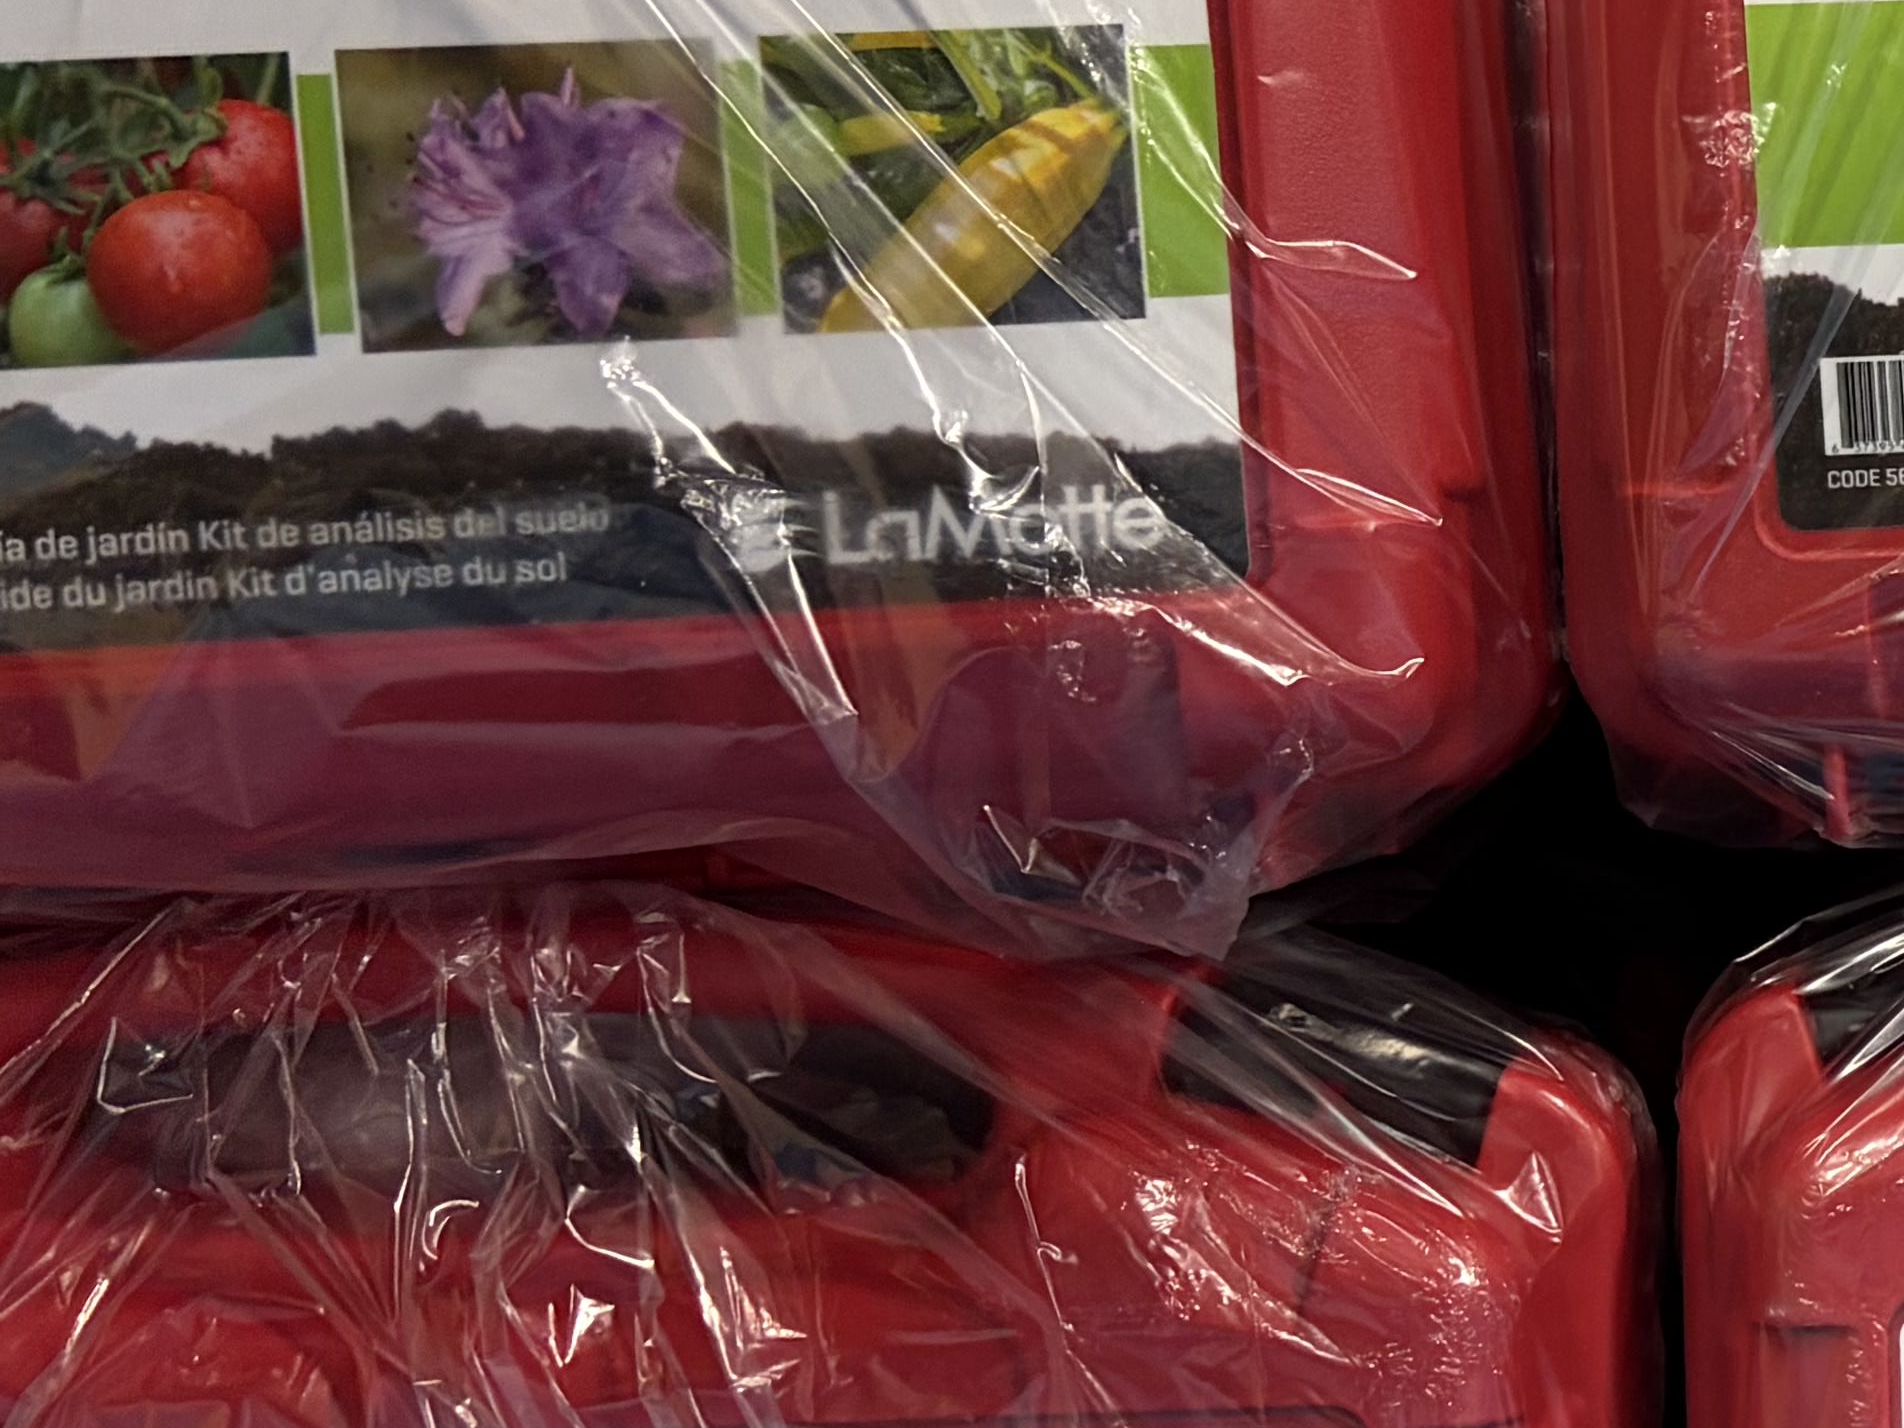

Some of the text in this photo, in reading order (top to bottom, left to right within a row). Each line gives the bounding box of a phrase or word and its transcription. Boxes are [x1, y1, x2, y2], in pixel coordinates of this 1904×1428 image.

[1828, 469, 1881, 489] CODE
[34, 527, 78, 560] de
[198, 519, 245, 552] Kit
[257, 515, 298, 548] de
[308, 509, 445, 545] análisis
[453, 505, 505, 539] del
[516, 501, 610, 536] suelo
[823, 484, 1165, 564] LaMotte
[62, 575, 106, 607] du
[114, 570, 218, 613] jardin
[228, 563, 274, 599] Kit
[285, 555, 453, 597] d'analyse
[462, 554, 506, 587] du
[516, 551, 568, 584] sol
